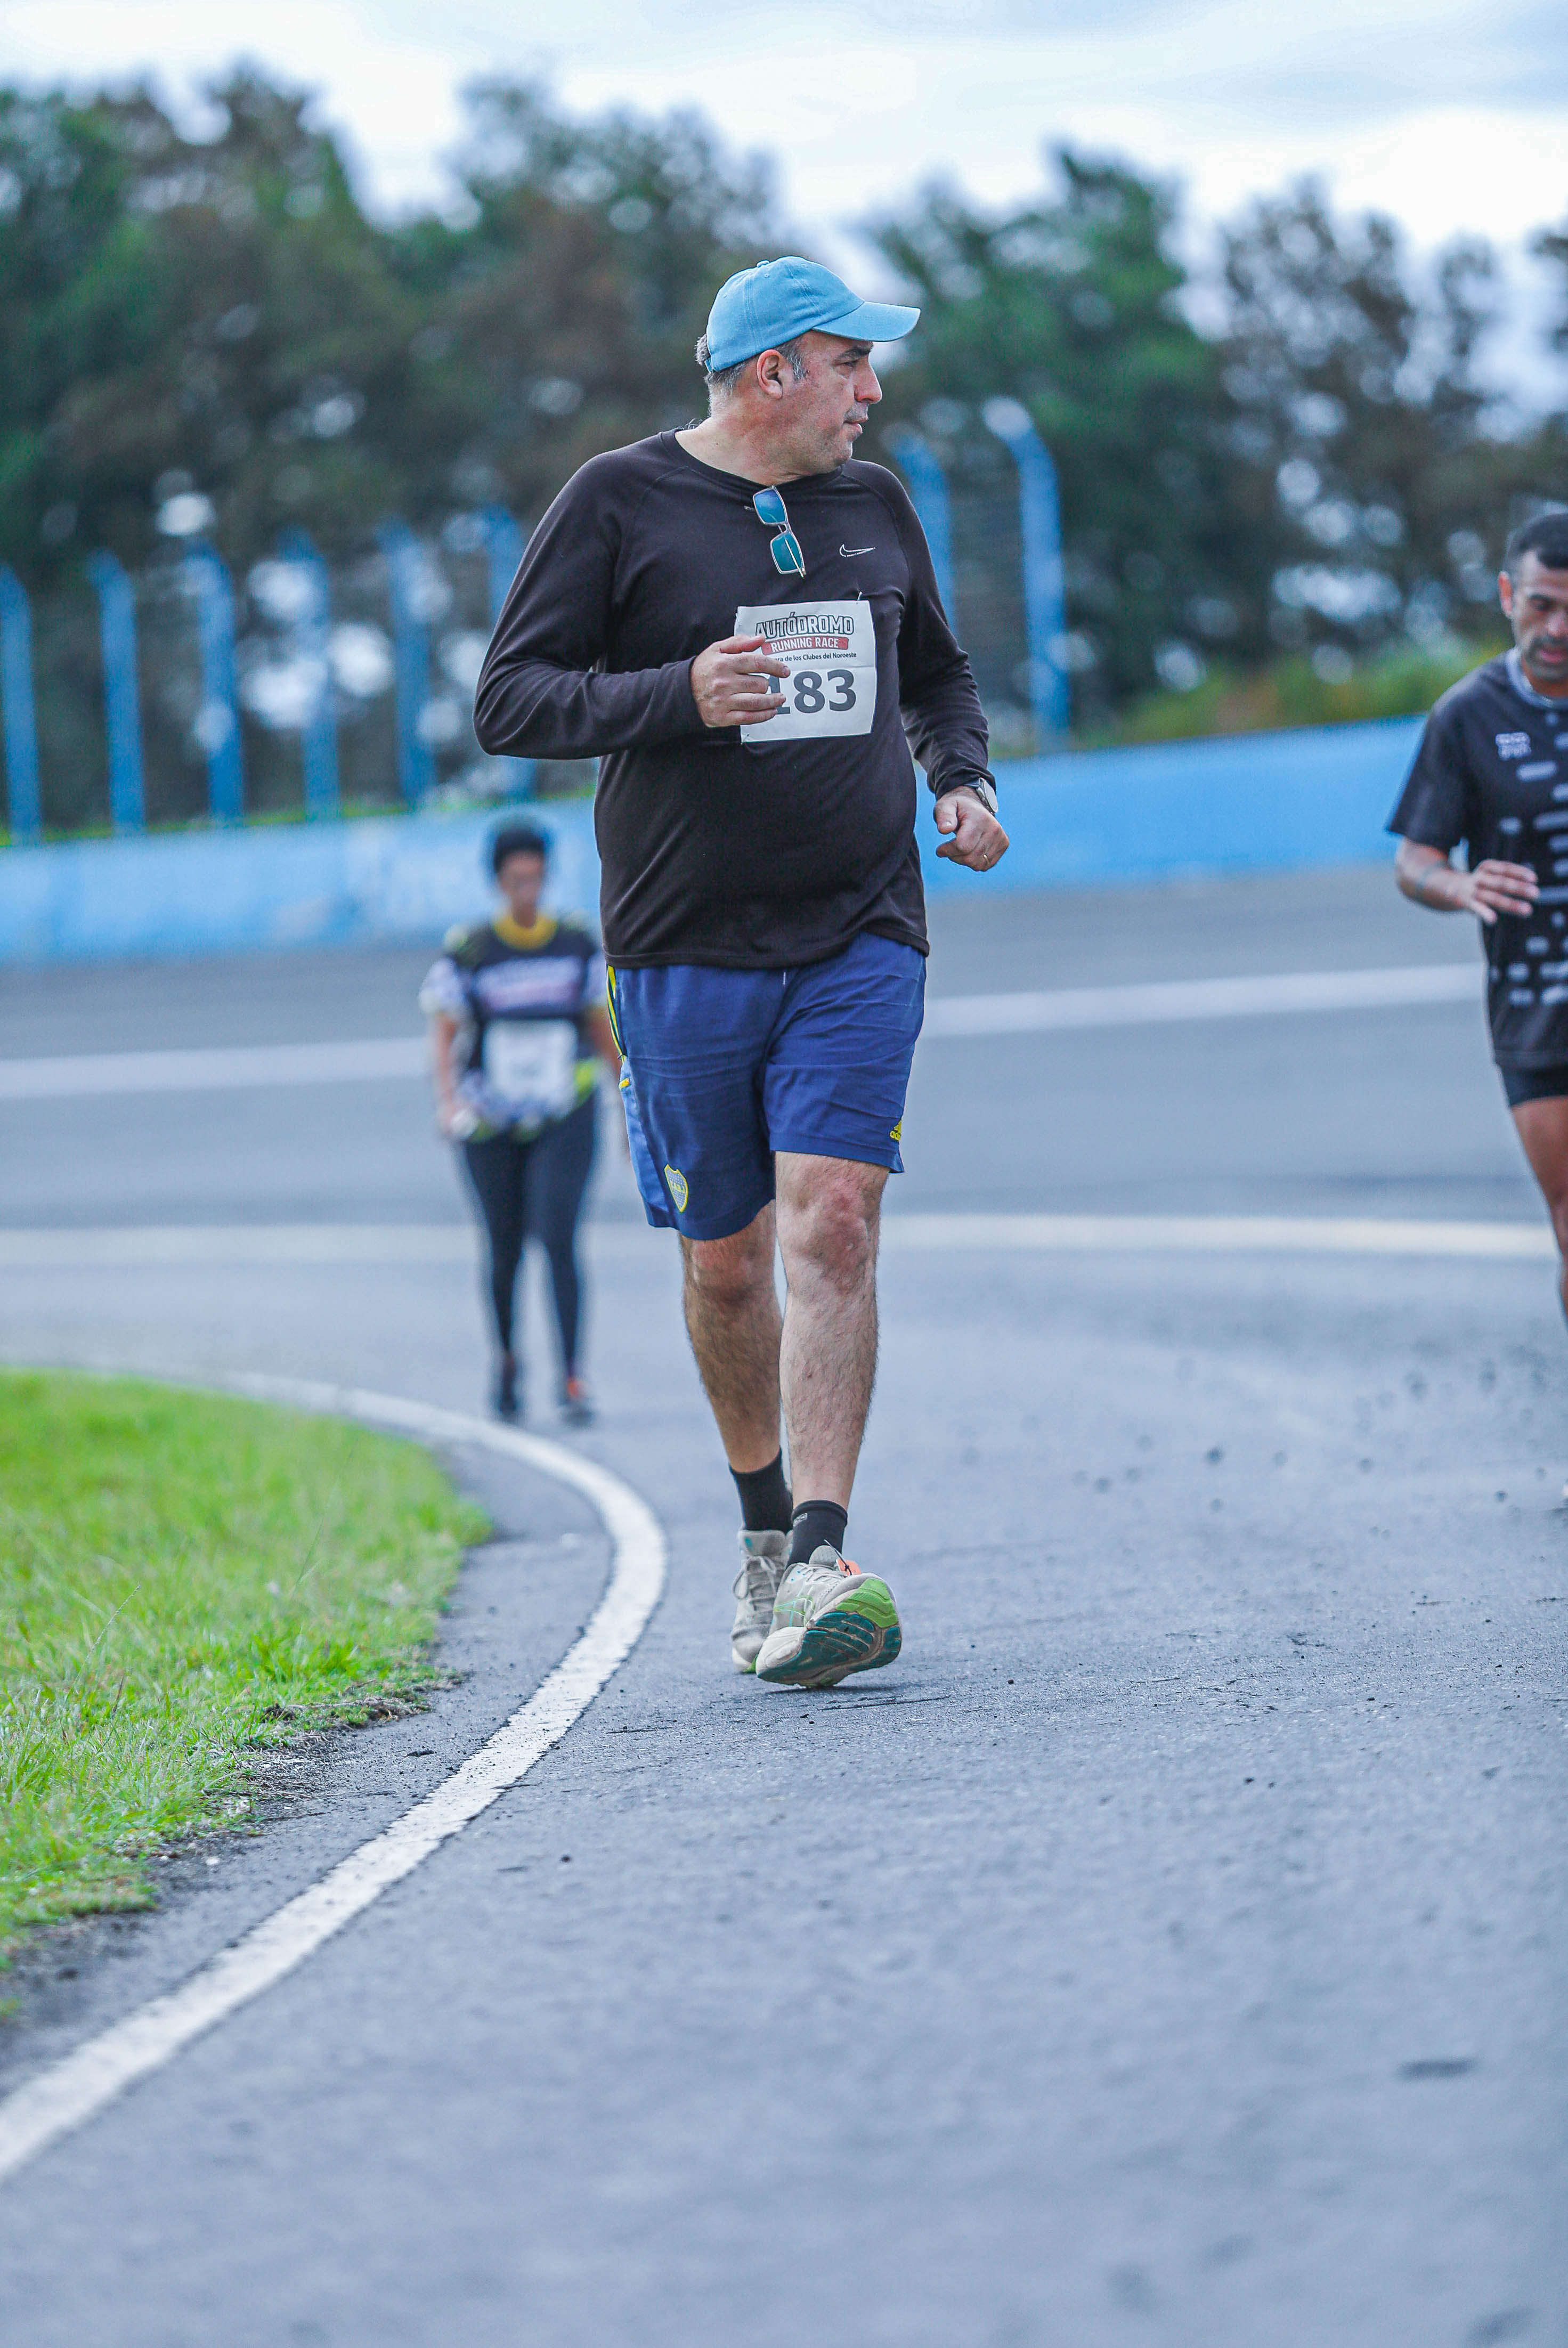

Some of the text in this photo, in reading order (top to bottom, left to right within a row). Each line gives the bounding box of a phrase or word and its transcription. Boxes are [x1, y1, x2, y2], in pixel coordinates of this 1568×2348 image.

[755, 612, 854, 639] AUTÓDROMO
[770, 637, 839, 653] RUNNING RACE
